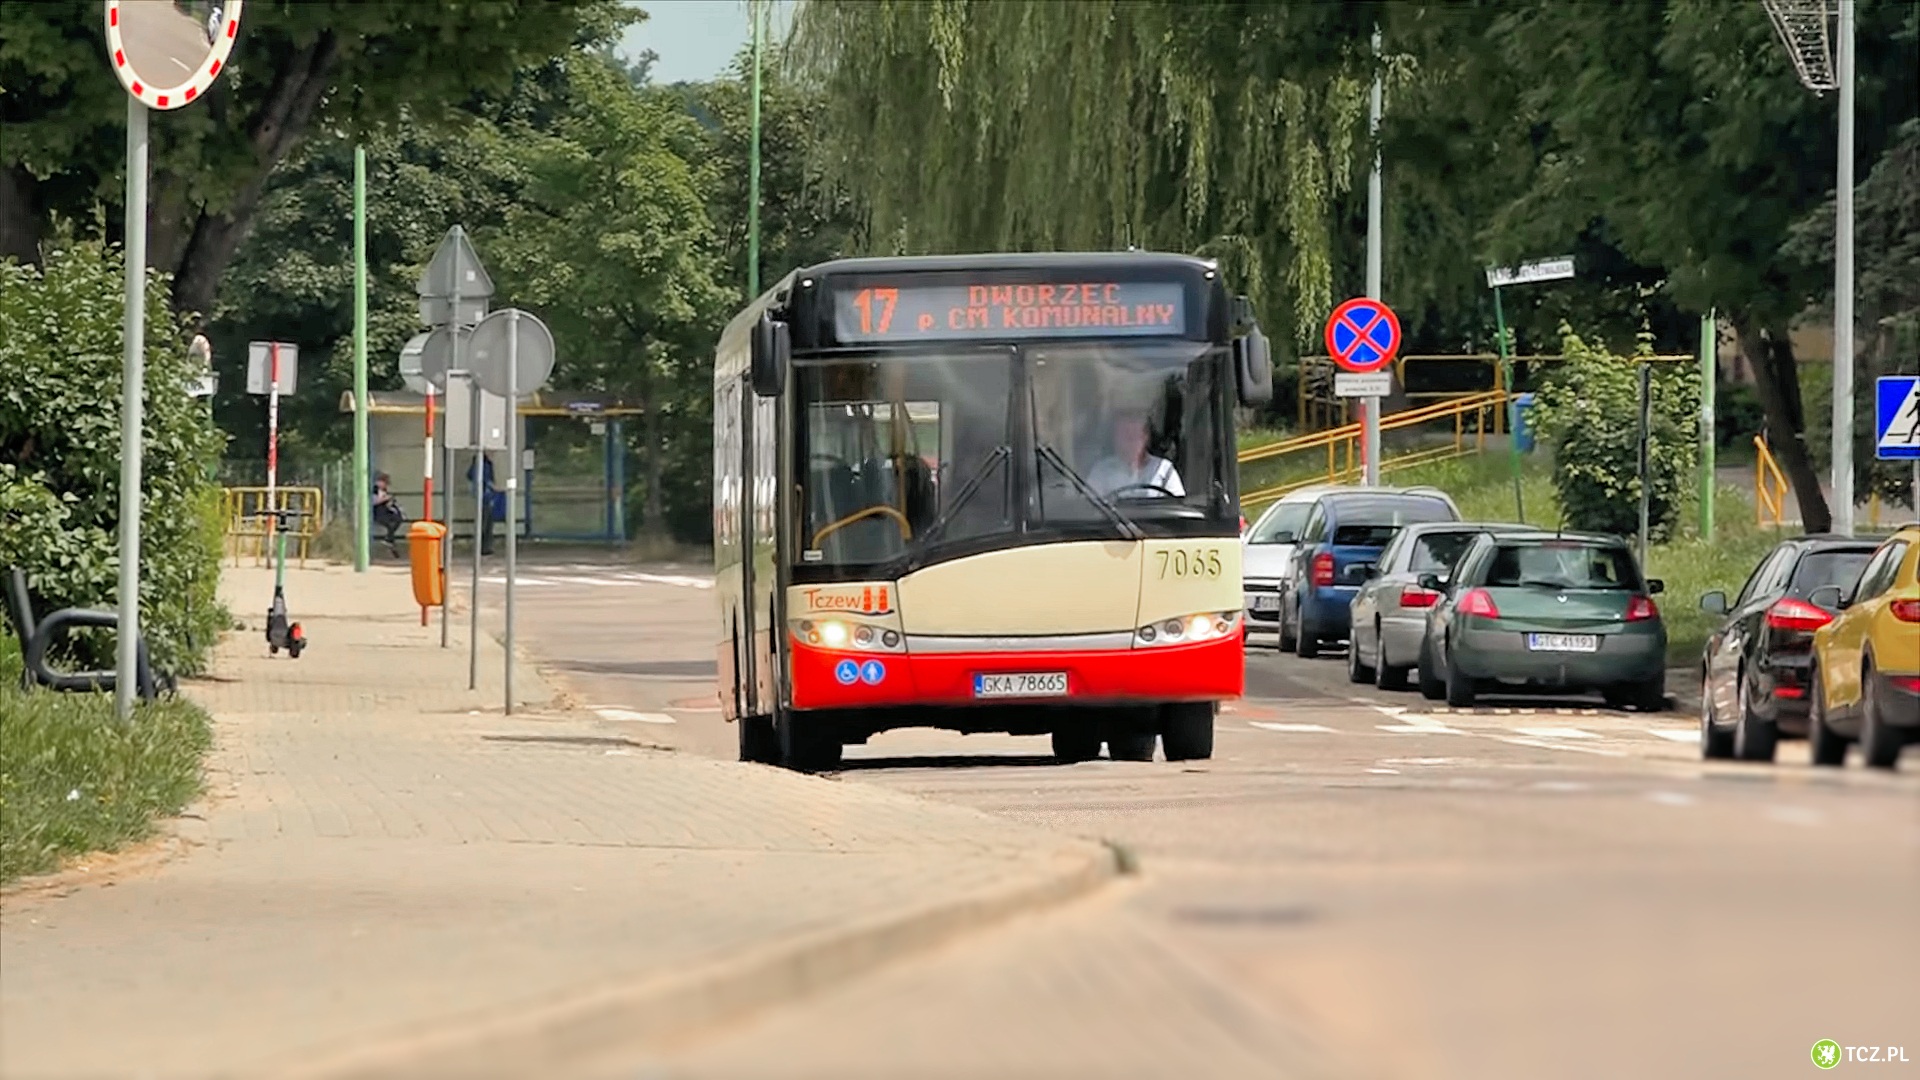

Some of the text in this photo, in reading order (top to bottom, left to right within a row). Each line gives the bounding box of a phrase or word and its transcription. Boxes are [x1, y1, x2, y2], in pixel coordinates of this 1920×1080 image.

[969, 283, 1122, 307] DWORZEC
[853, 288, 899, 334] 17
[1002, 303, 1175, 328] KOMUNALNY
[1156, 548, 1222, 579] 7065
[803, 587, 862, 610] Tczew
[983, 674, 1066, 692] GKA 78665
